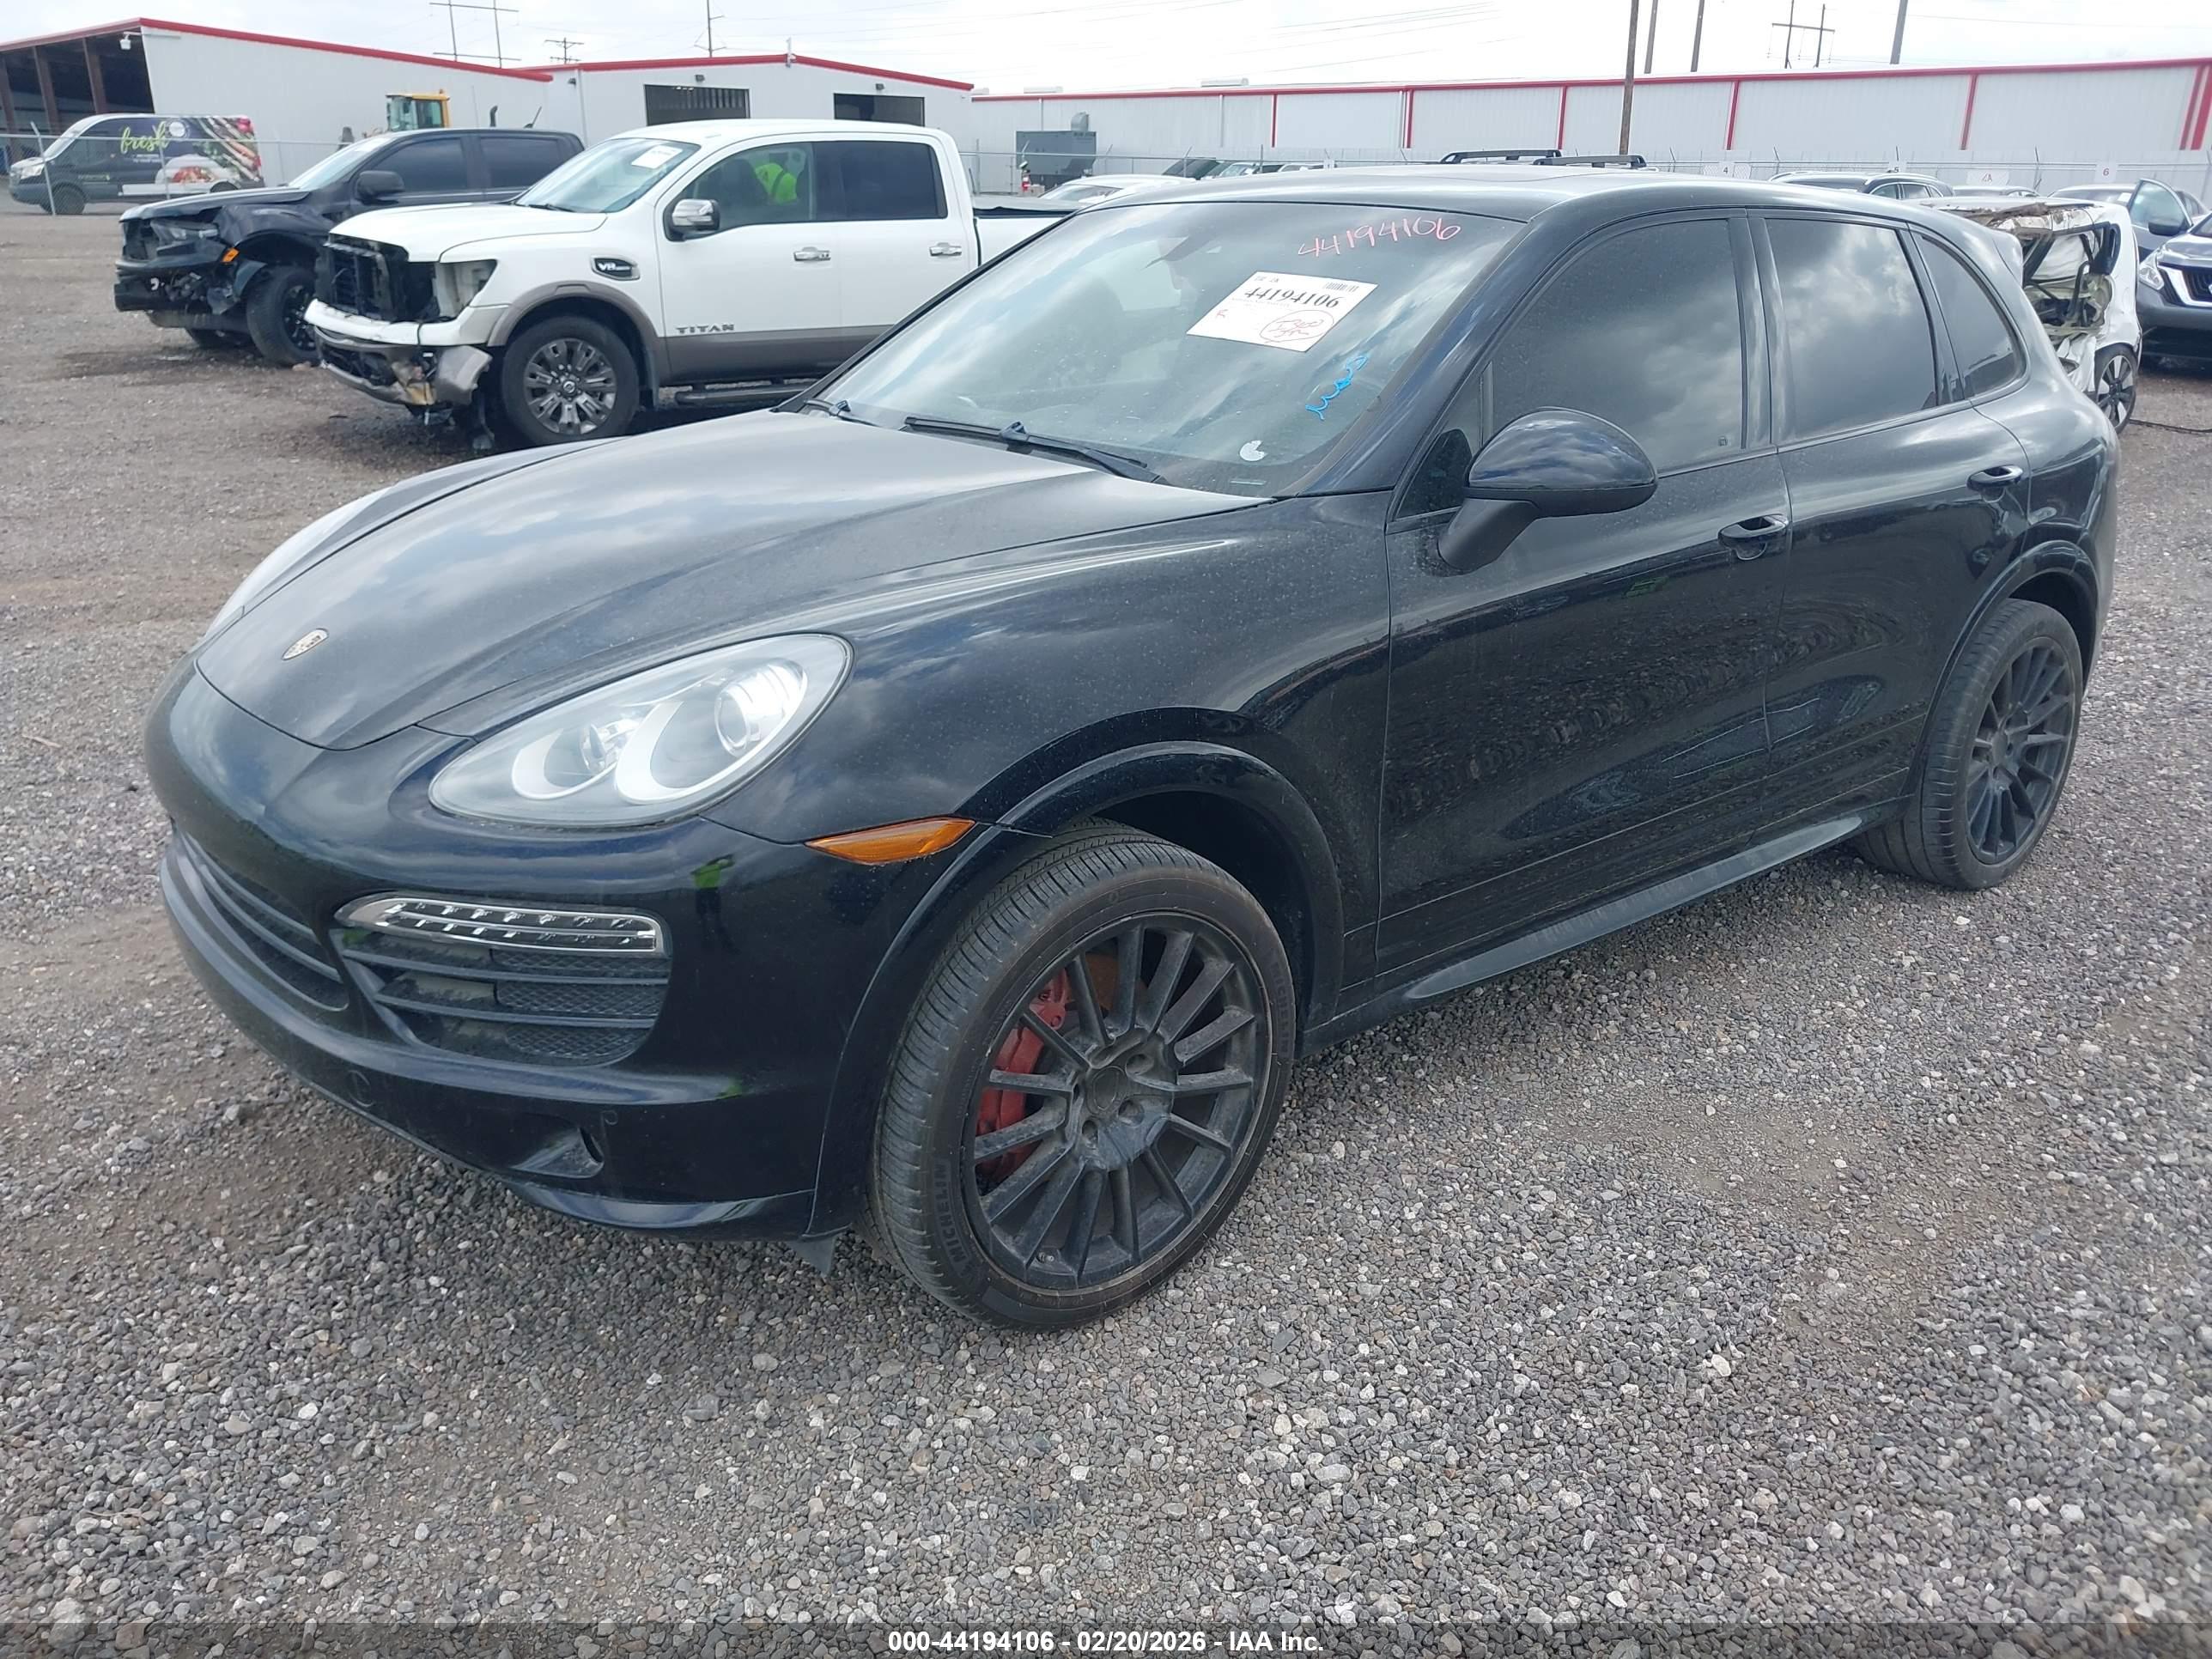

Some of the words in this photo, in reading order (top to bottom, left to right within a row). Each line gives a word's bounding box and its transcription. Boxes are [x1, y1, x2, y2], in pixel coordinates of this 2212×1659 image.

[120, 121, 170, 154] fresh
[2102, 167, 2110, 176] 6
[1297, 216, 1462, 257] 44194106
[598, 262, 617, 270] V8
[1243, 286, 1345, 309] 44194106
[676, 324, 735, 334] TITAN
[934, 1163, 968, 1263] MICHELIN
